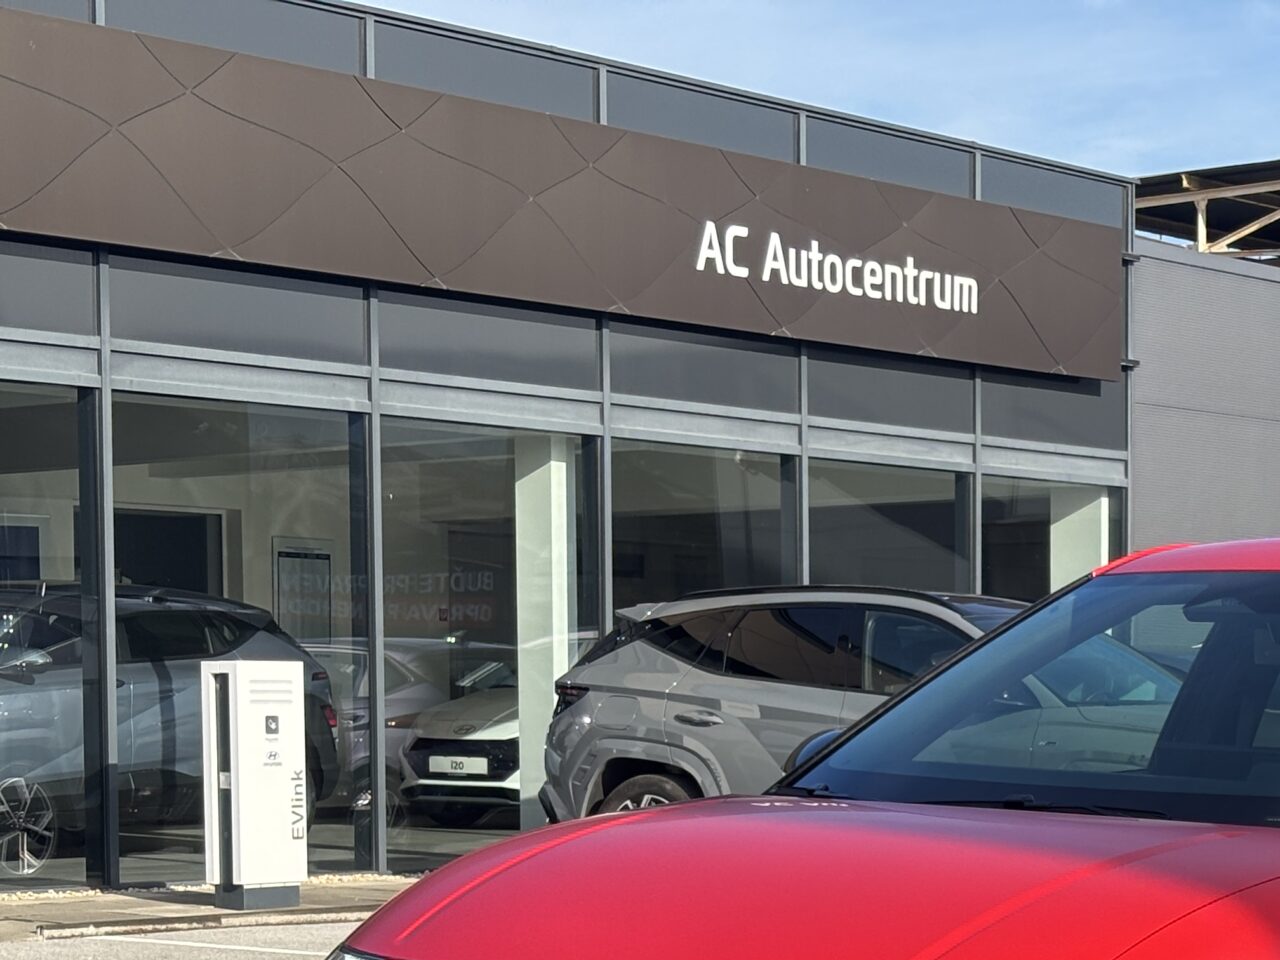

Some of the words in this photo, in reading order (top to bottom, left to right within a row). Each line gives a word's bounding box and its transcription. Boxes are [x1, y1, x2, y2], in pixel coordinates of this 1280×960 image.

[696, 220, 749, 278] AC
[762, 231, 979, 314] Autocentrum
[291, 769, 305, 841] EVlink
